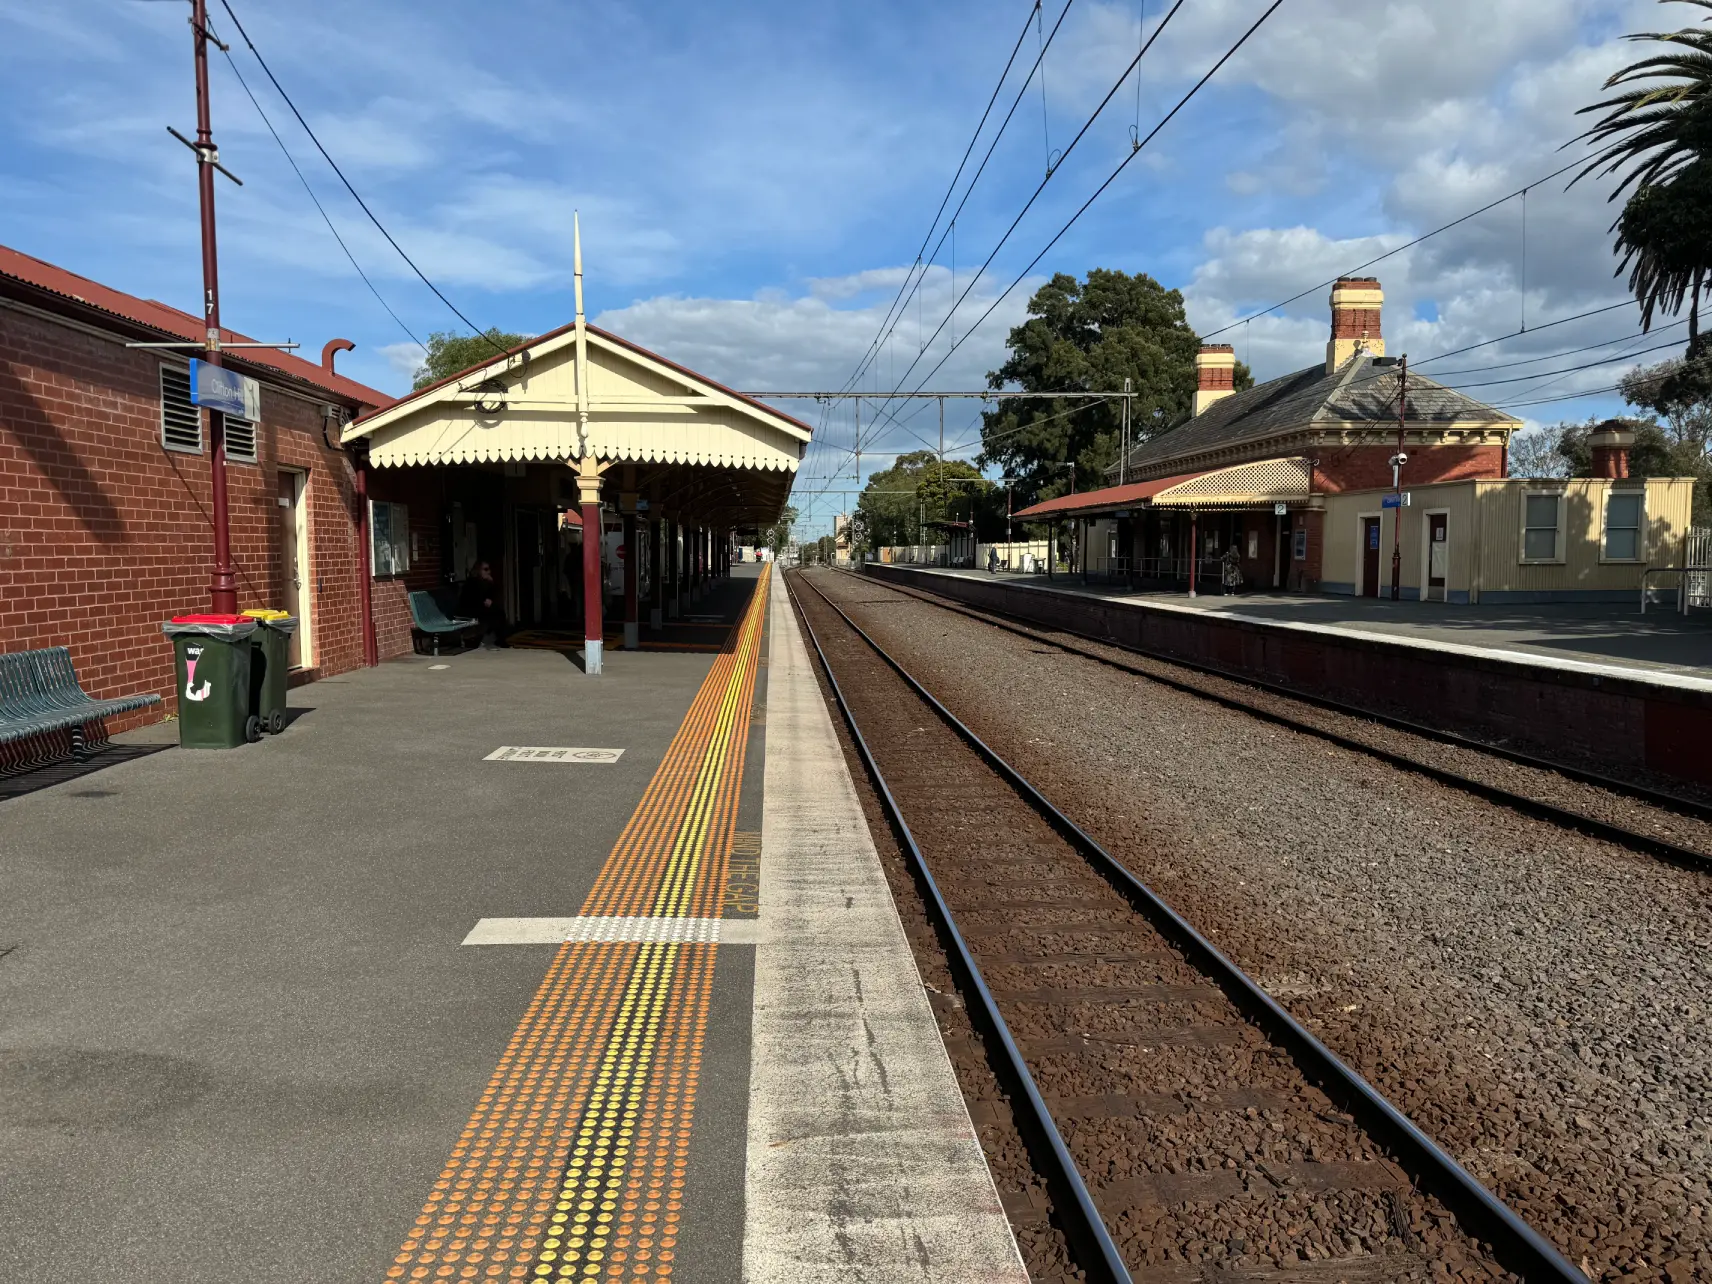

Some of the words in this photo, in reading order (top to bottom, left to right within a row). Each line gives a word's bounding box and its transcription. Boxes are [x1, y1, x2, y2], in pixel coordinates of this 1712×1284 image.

[211, 378, 233, 399] Clifton
[1277, 504, 1285, 514] 2
[1402, 494, 1408, 506] 2
[727, 857, 761, 879] THE
[724, 883, 759, 913] GAP
